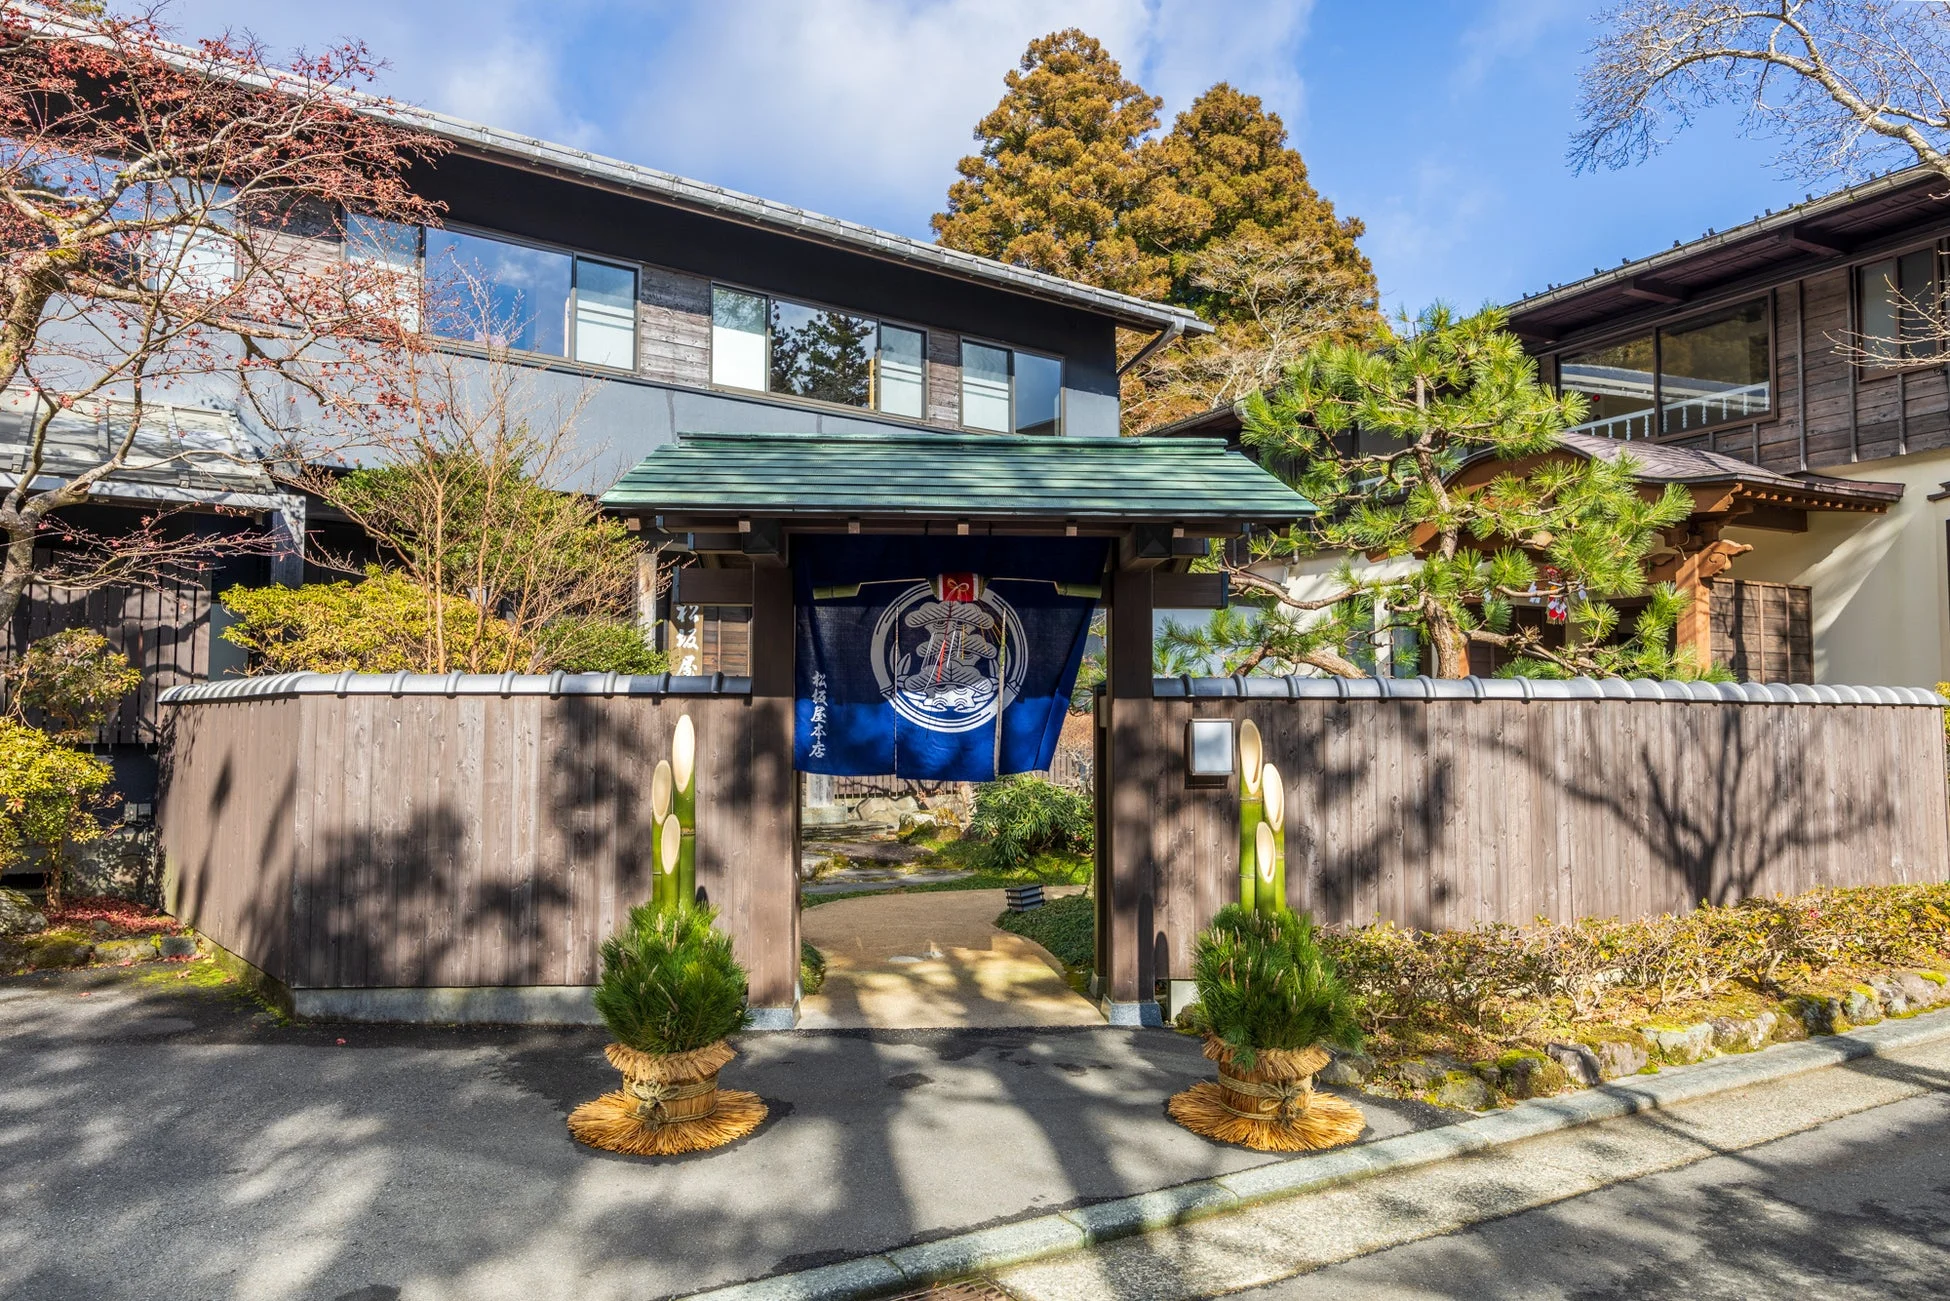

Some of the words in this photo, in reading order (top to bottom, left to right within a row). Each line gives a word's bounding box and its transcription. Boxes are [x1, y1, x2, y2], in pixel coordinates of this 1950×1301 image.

[808, 670, 828, 758] 松坂屋本店
